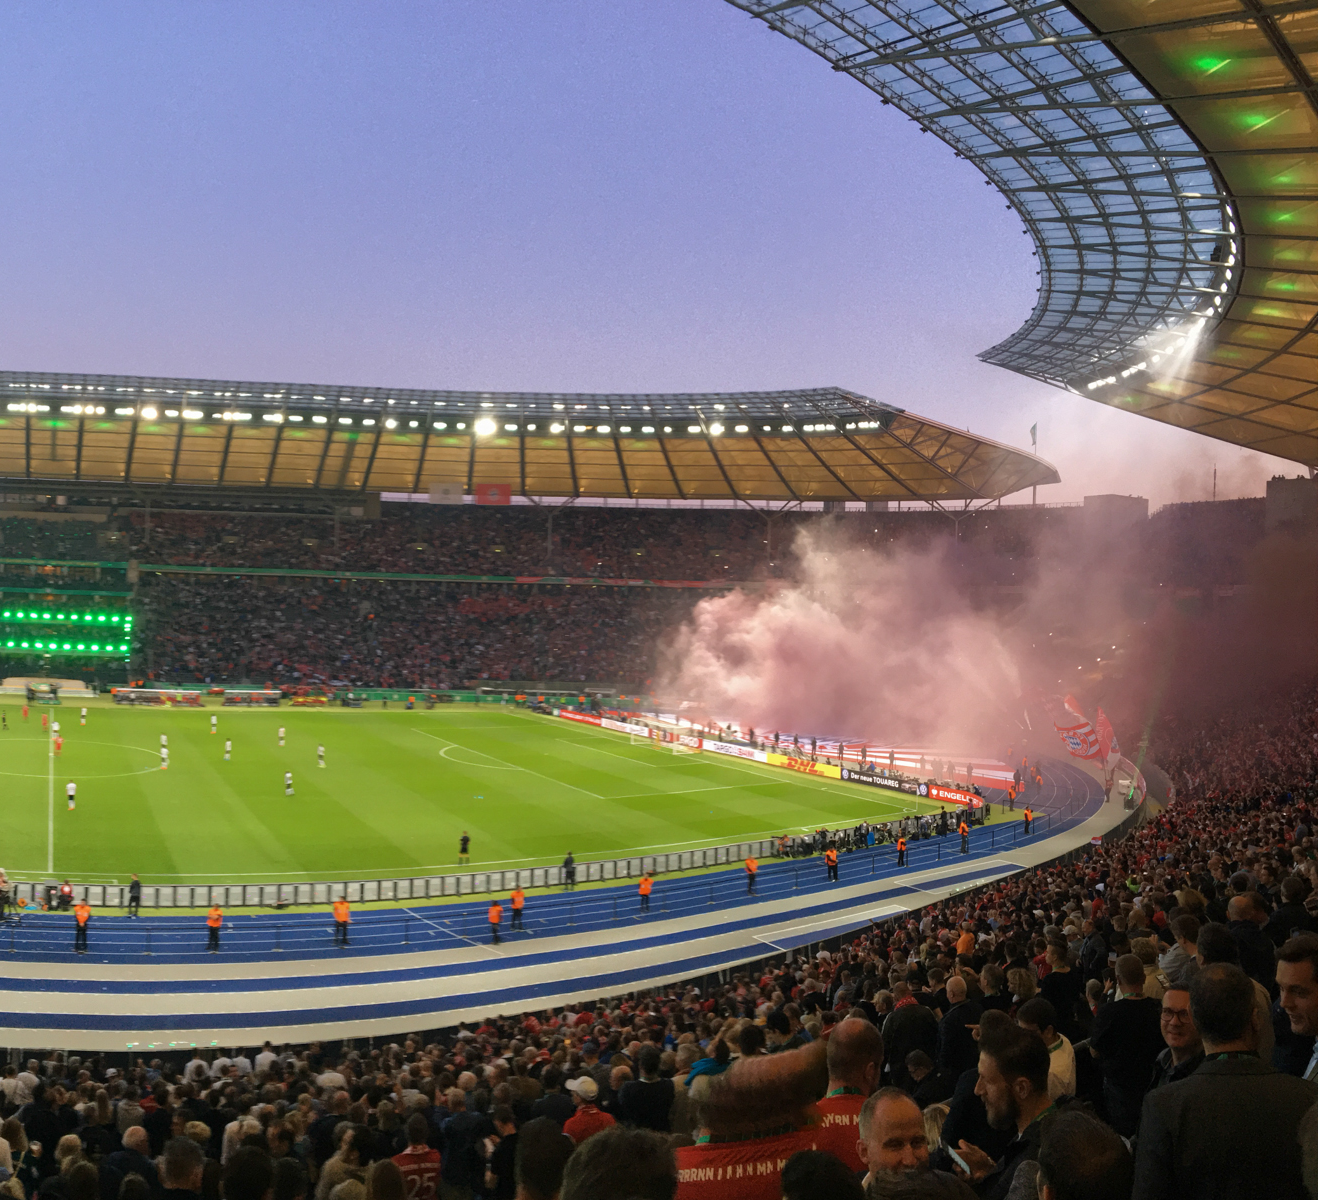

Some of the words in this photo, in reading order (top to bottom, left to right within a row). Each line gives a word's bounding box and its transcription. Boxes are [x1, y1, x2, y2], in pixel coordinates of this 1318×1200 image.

[786, 756, 819, 774] DHL
[850, 771, 860, 780] Der
[860, 774, 873, 783] neue
[873, 776, 899, 788] TOUAREG
